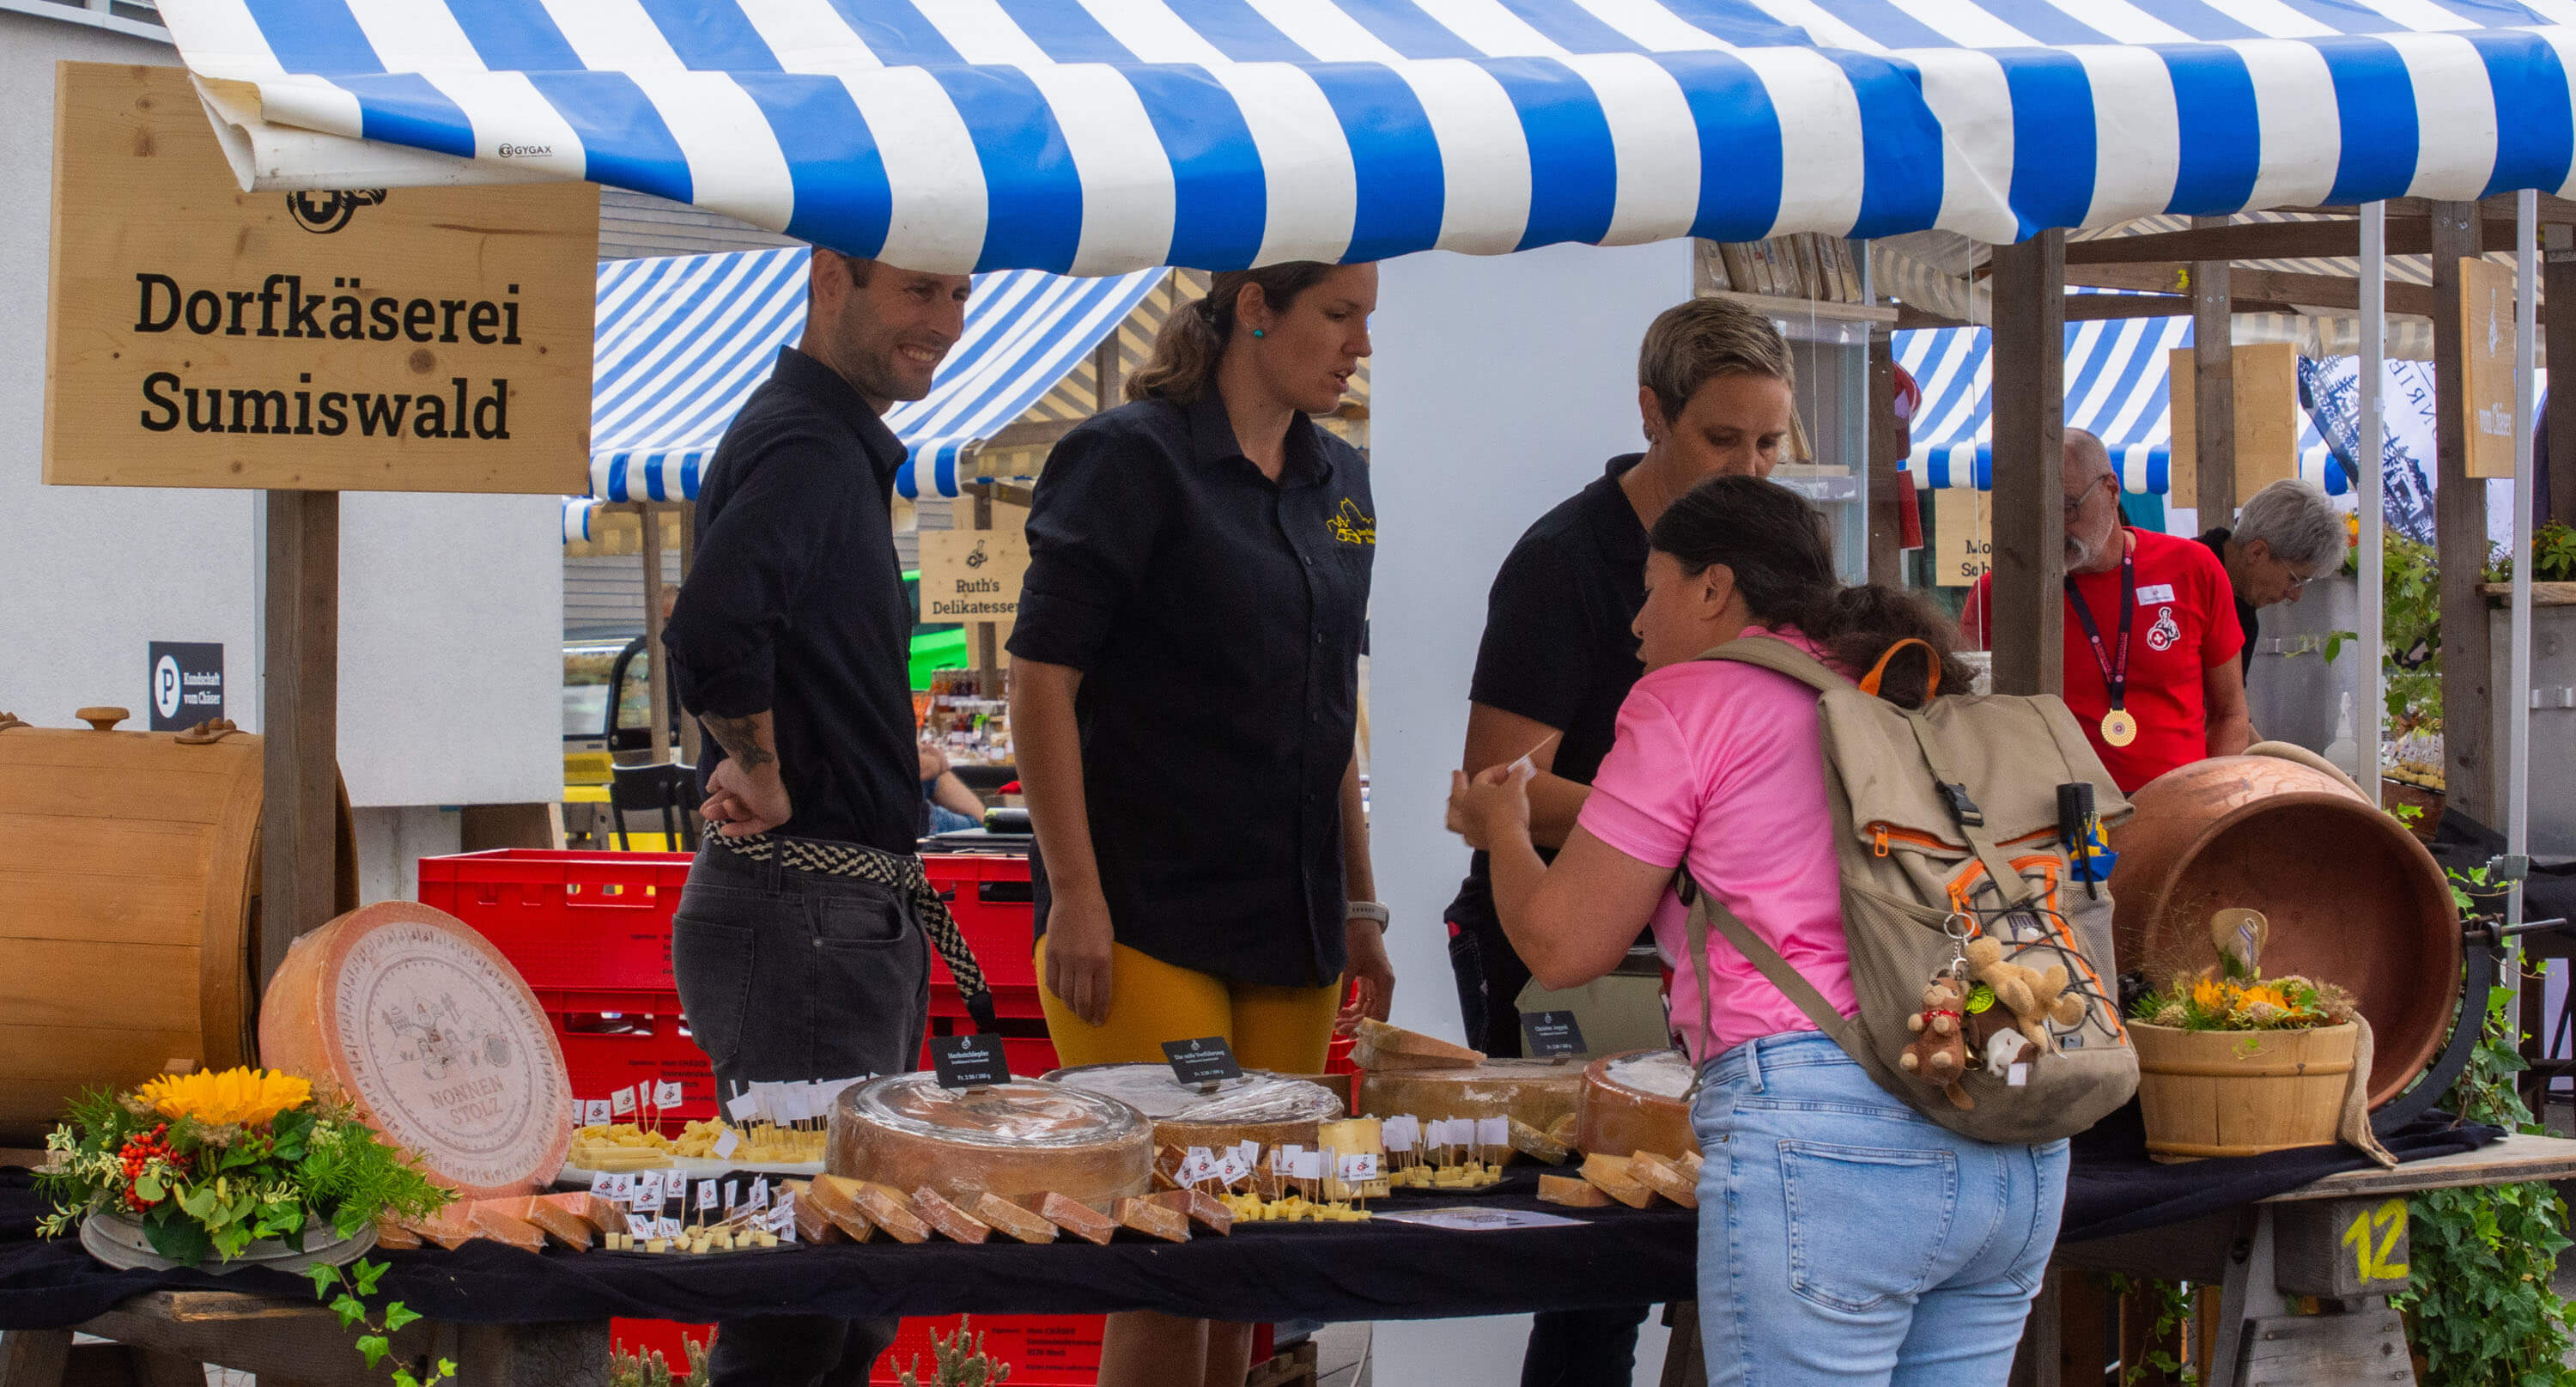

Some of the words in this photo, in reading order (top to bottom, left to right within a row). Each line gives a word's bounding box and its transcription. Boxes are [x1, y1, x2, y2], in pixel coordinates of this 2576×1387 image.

[134, 273, 521, 344] Dorfkäserei
[141, 372, 510, 440] Sumiswald
[955, 578, 1000, 593] Ruth's
[162, 668, 175, 704] P
[429, 1075, 504, 1109] NONNEN
[450, 1098, 502, 1125] STOLZ
[2342, 1198, 2409, 1286] 12
